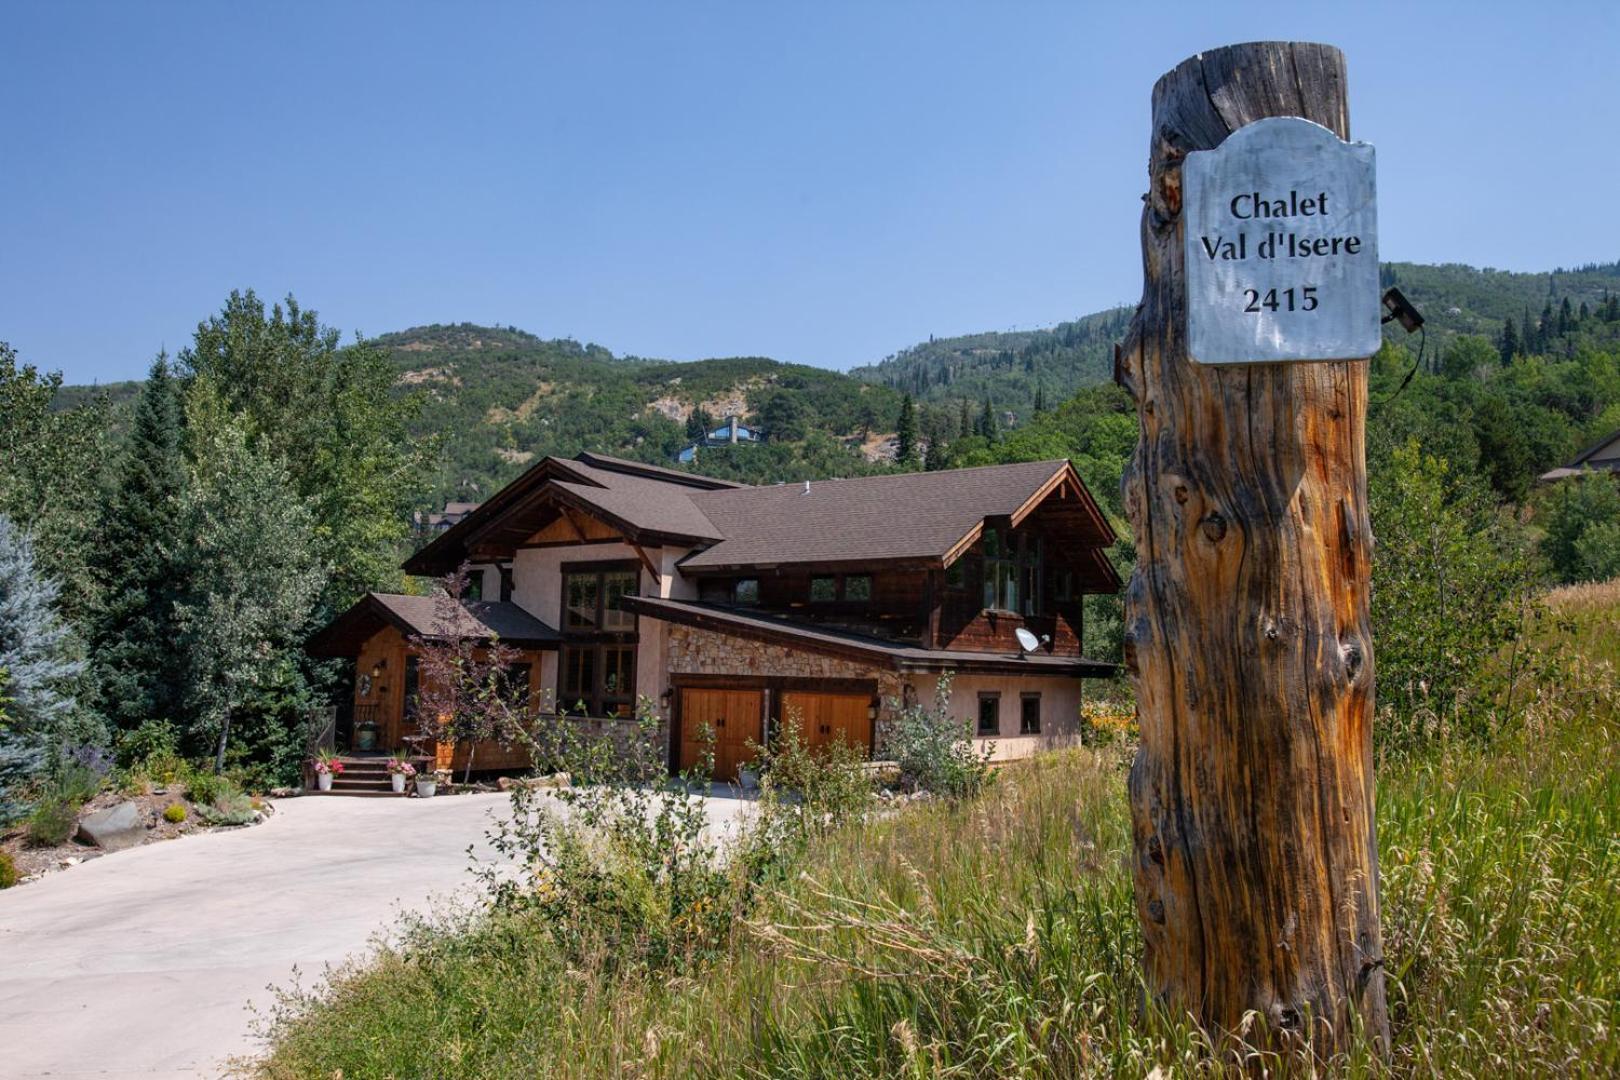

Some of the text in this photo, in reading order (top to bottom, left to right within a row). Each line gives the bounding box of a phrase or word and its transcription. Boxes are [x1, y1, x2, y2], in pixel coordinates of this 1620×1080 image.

[1230, 190, 1329, 220] Chalet
[1201, 232, 1362, 261] Val d'Isere
[1243, 286, 1319, 313] 2415
